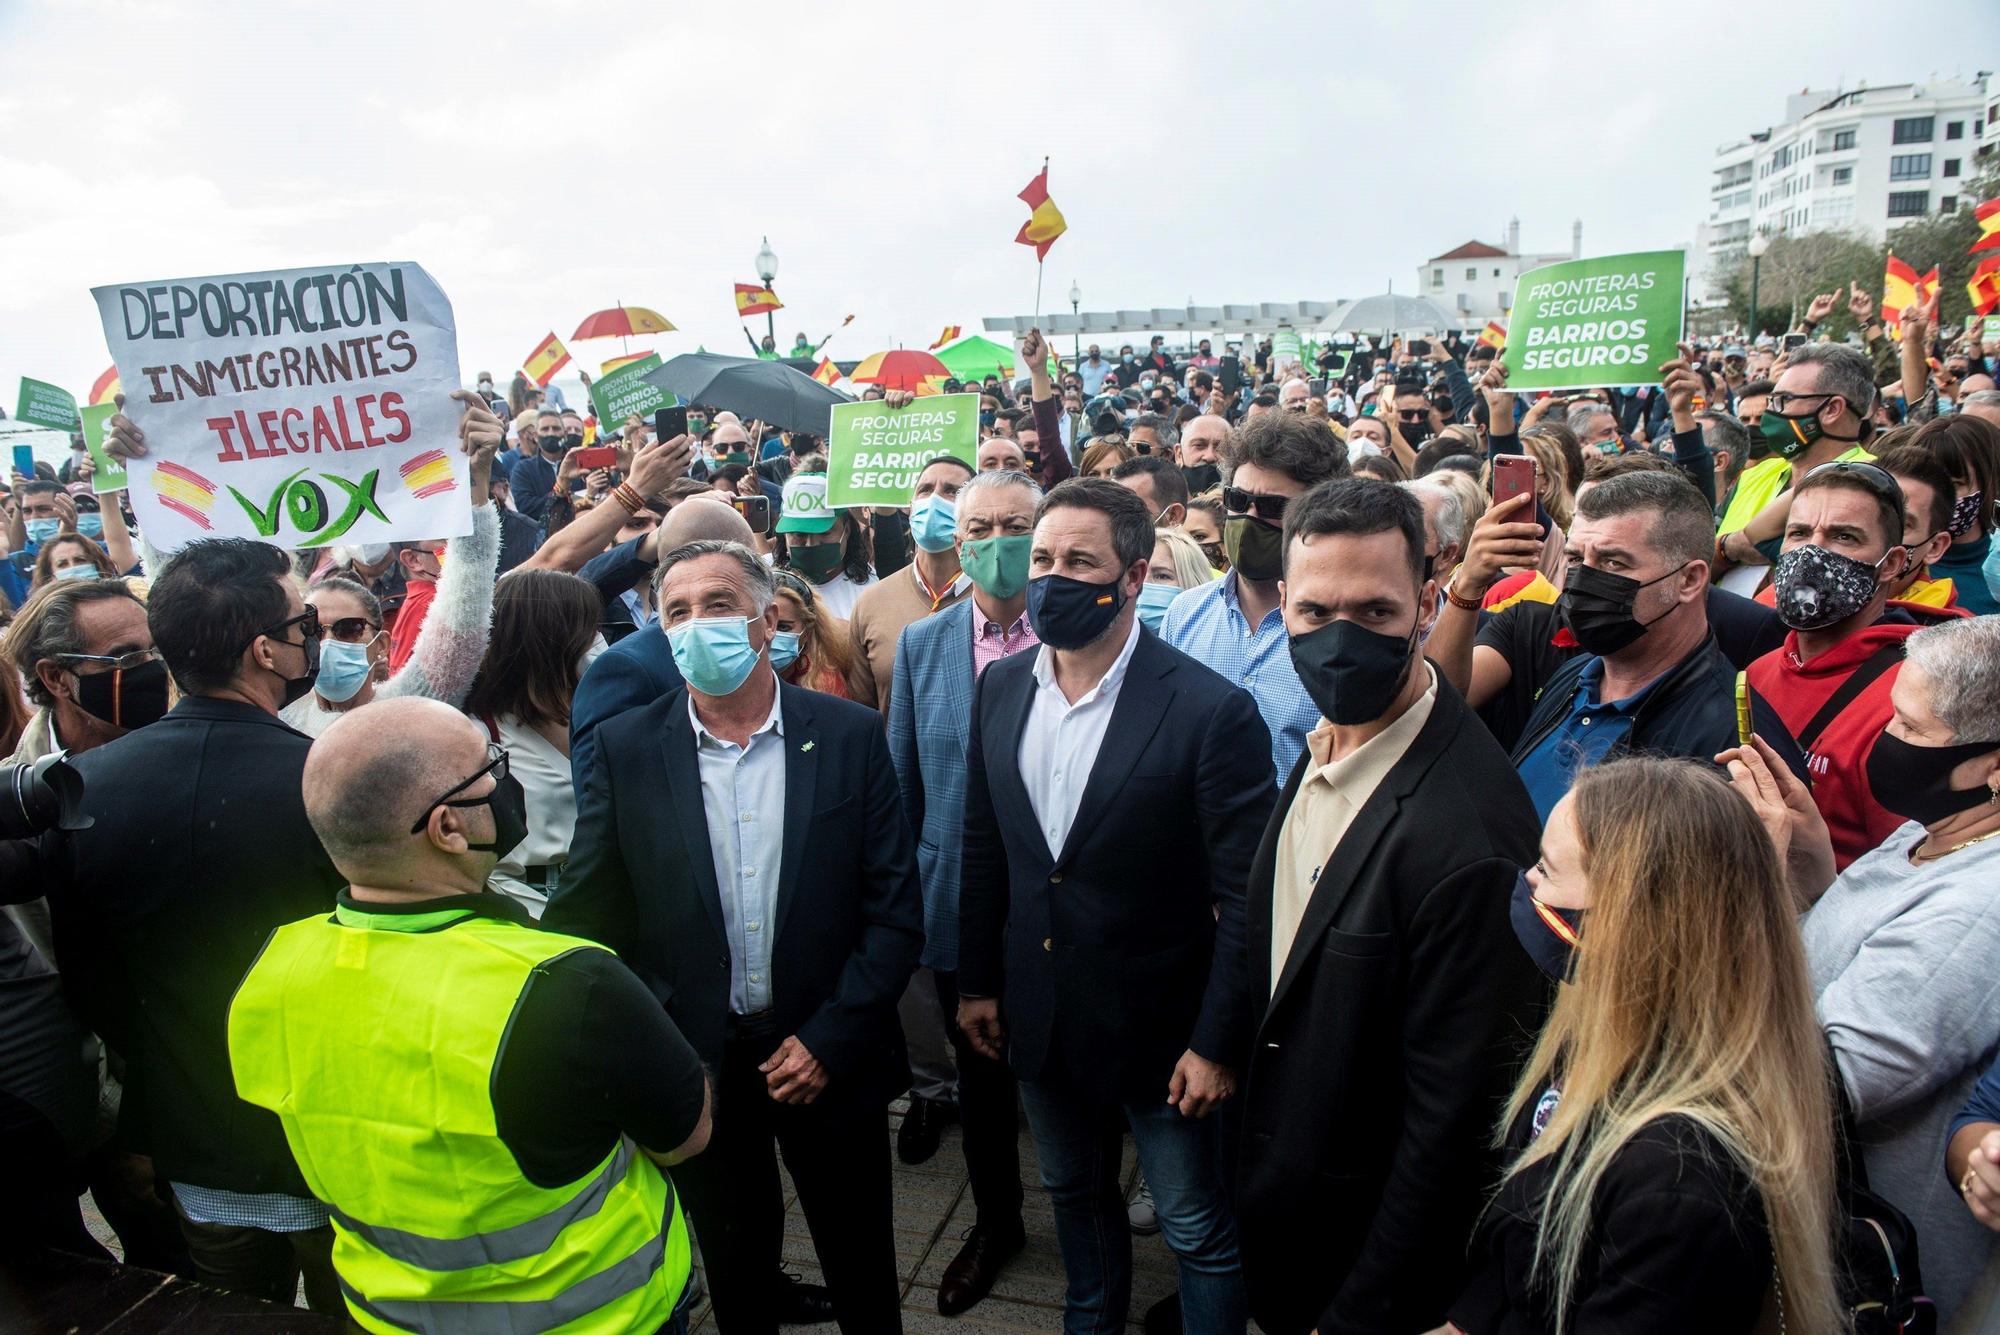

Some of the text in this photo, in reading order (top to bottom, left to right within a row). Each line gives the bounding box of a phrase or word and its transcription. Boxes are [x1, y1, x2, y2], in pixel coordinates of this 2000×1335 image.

[1528, 271, 1656, 302] FRONTERAS
[119, 264, 409, 341] DEPORTACIÓN
[1536, 293, 1639, 319] SEGURAS
[1526, 319, 1648, 347] BARRIOS
[142, 330, 418, 404] INMIGRANTES
[1522, 344, 1650, 371] SEGUROS
[600, 364, 655, 395] FRONTERAS
[608, 385, 659, 412] BARRIOS
[611, 393, 664, 422] SEGUROS
[206, 391, 412, 463] ILEGALES
[851, 411, 957, 431] FRONTERAS
[861, 428, 944, 446] SEGURAS
[226, 467, 392, 547] VOX
[787, 491, 826, 512] VOX
